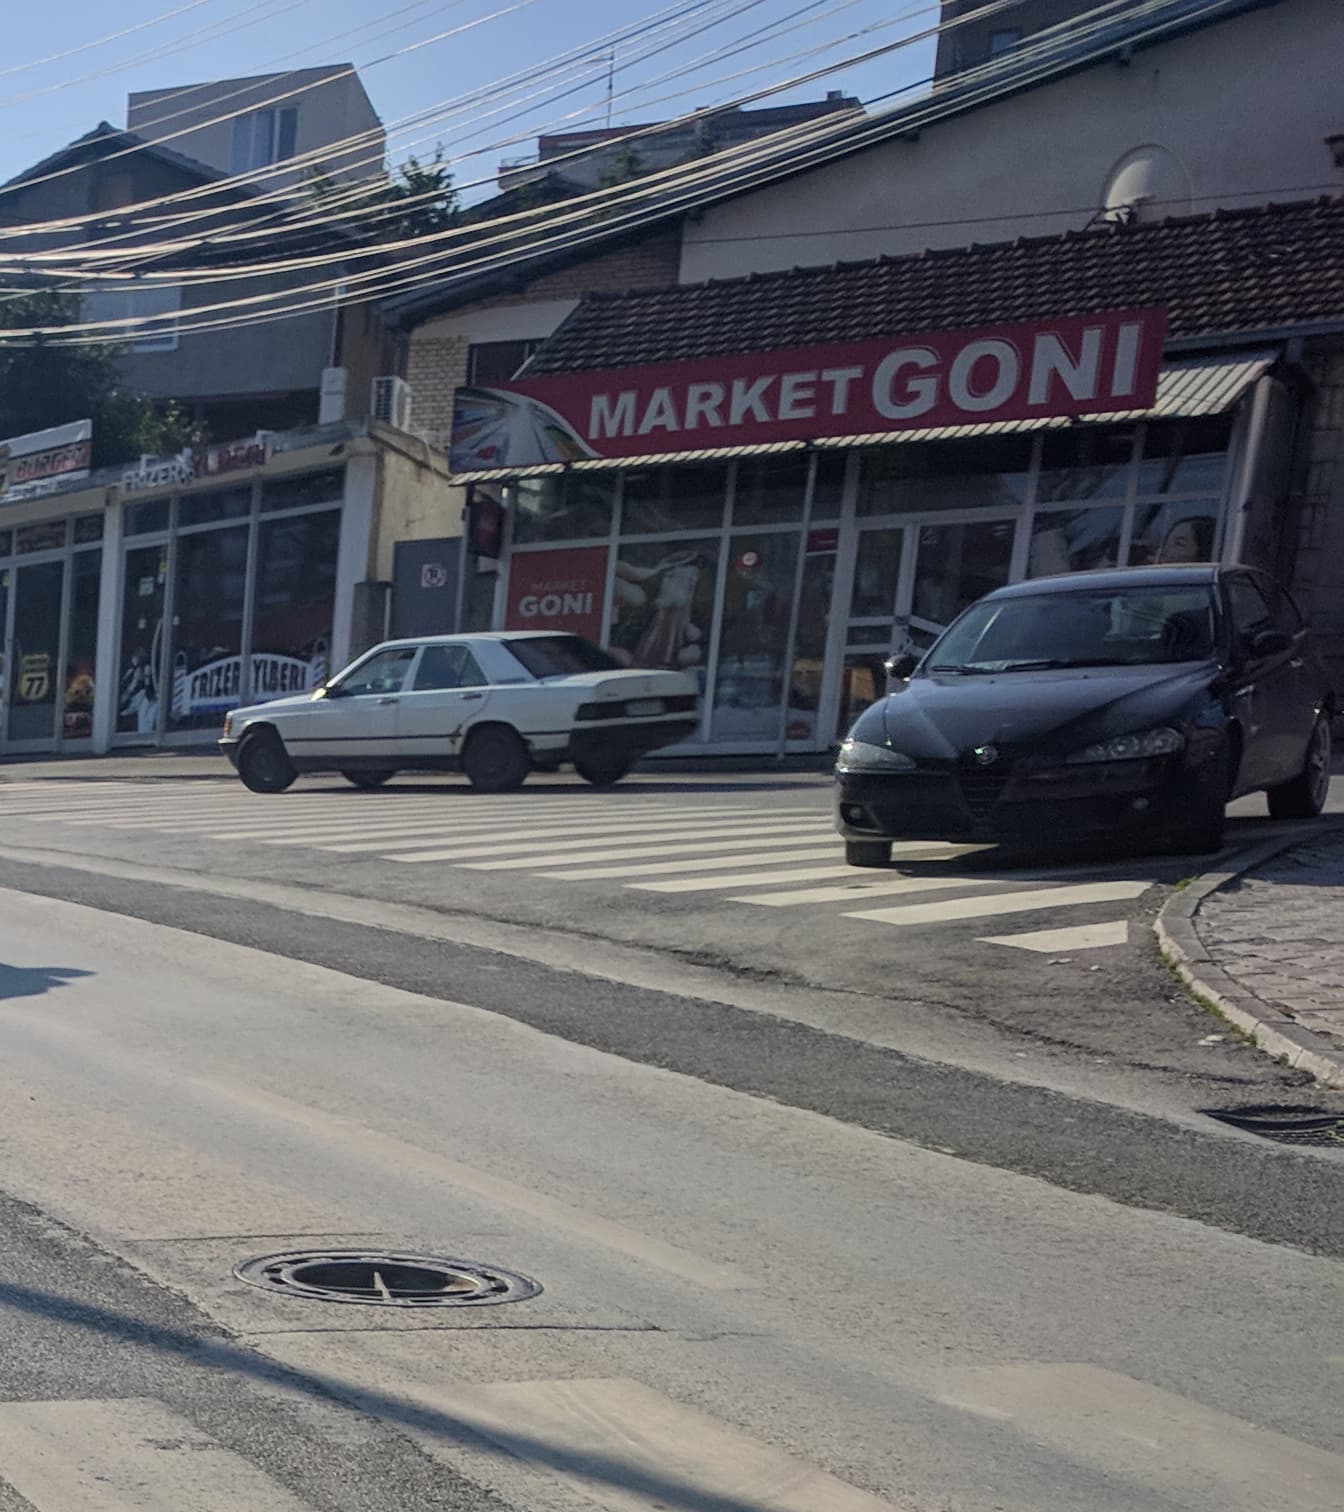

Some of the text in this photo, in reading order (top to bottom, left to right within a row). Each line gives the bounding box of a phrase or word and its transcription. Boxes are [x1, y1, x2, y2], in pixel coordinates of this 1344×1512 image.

[589, 320, 1142, 440] MARKET GONI
[518, 593, 592, 618] GONI
[191, 659, 307, 699] FRIZER YLBERI
